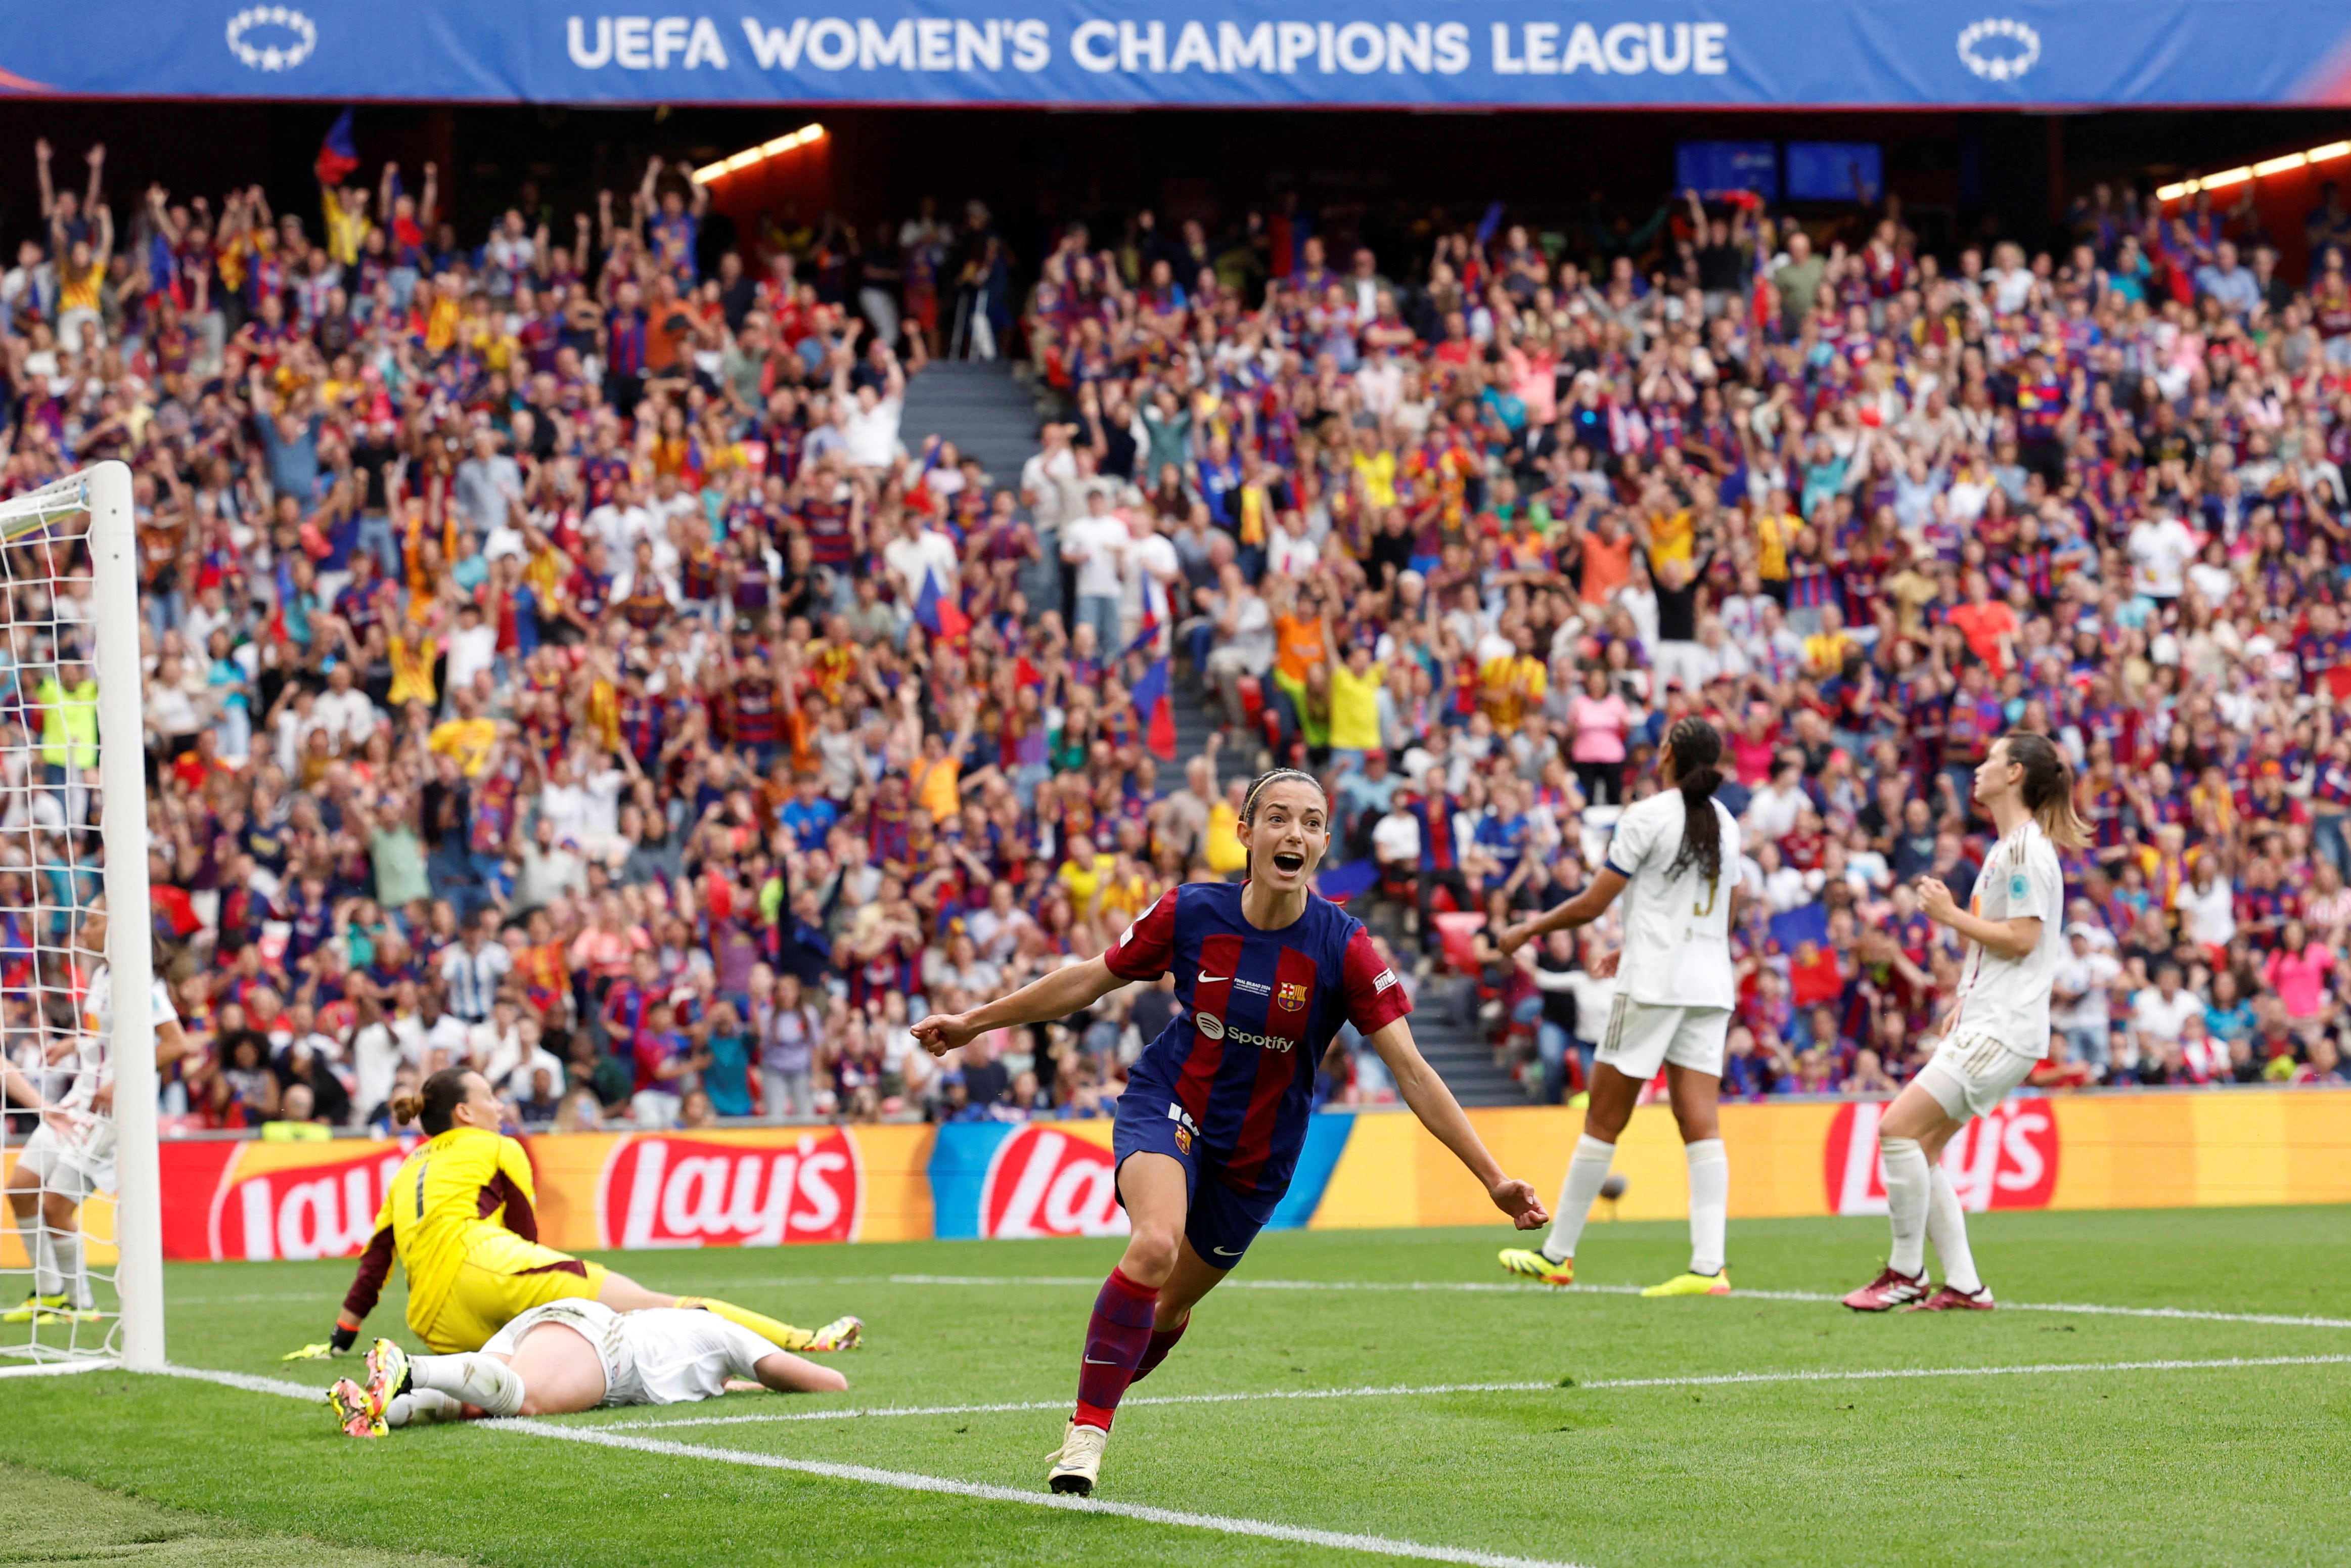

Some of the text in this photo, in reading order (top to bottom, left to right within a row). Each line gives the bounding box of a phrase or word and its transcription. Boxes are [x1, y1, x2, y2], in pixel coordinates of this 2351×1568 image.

[567, 17, 1727, 74] UEFA WOMEN'S CHAMPIONS LEAGUE
[1228, 1026, 1294, 1053] Spotify
[622, 1134, 847, 1249] Lay's
